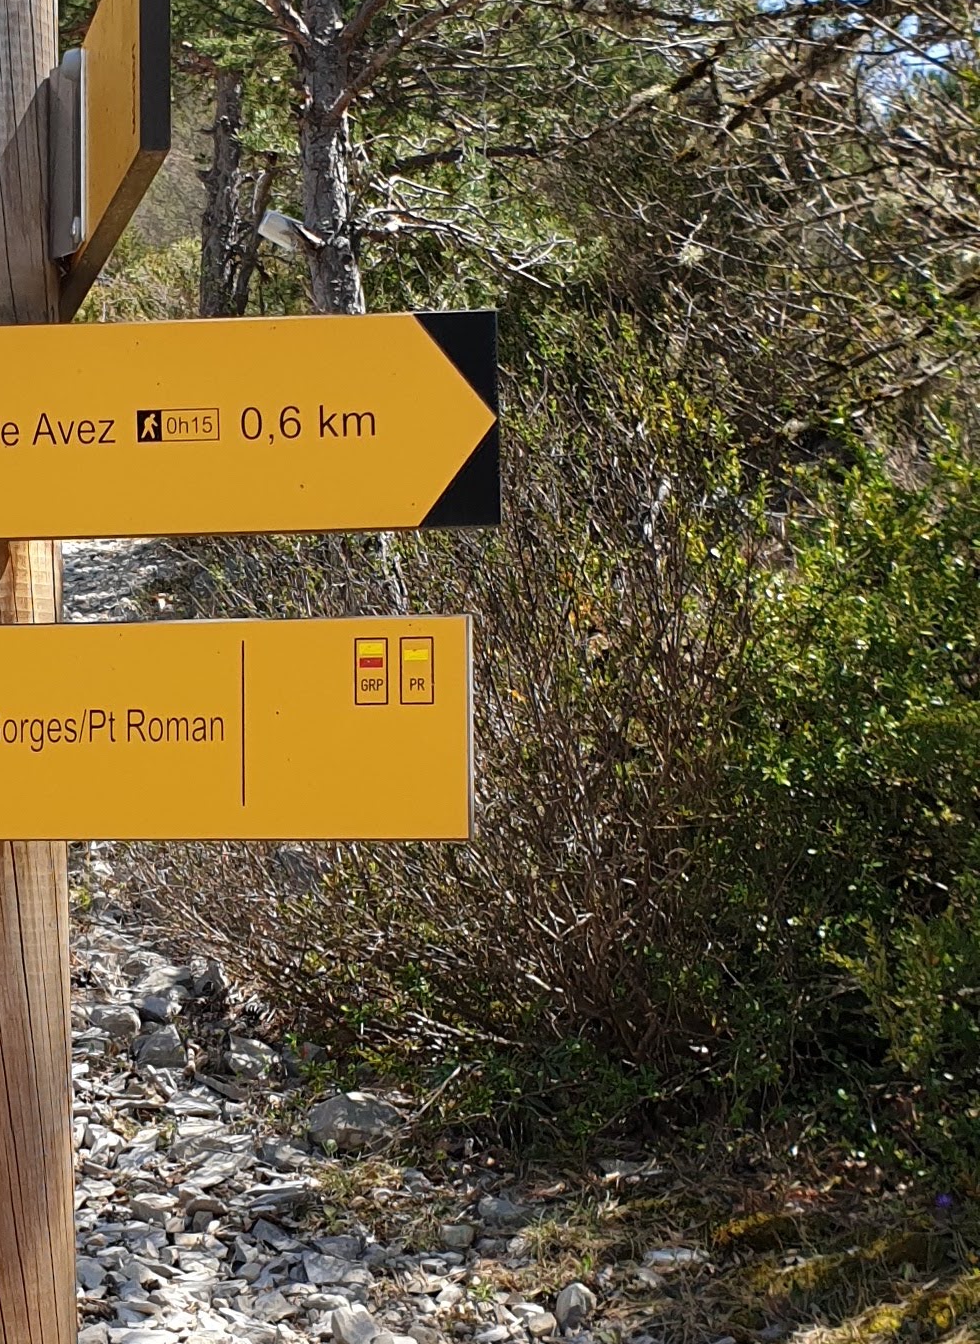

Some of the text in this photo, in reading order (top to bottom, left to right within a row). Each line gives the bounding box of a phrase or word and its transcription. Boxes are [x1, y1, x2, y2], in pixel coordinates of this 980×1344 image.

[32, 412, 116, 446] Avez
[166, 415, 213, 435] 0h15
[240, 405, 302, 445] 0,6
[319, 404, 376, 438] km
[360, 678, 384, 692] GRP
[409, 677, 425, 691] PR
[127, 708, 224, 743] Roman
